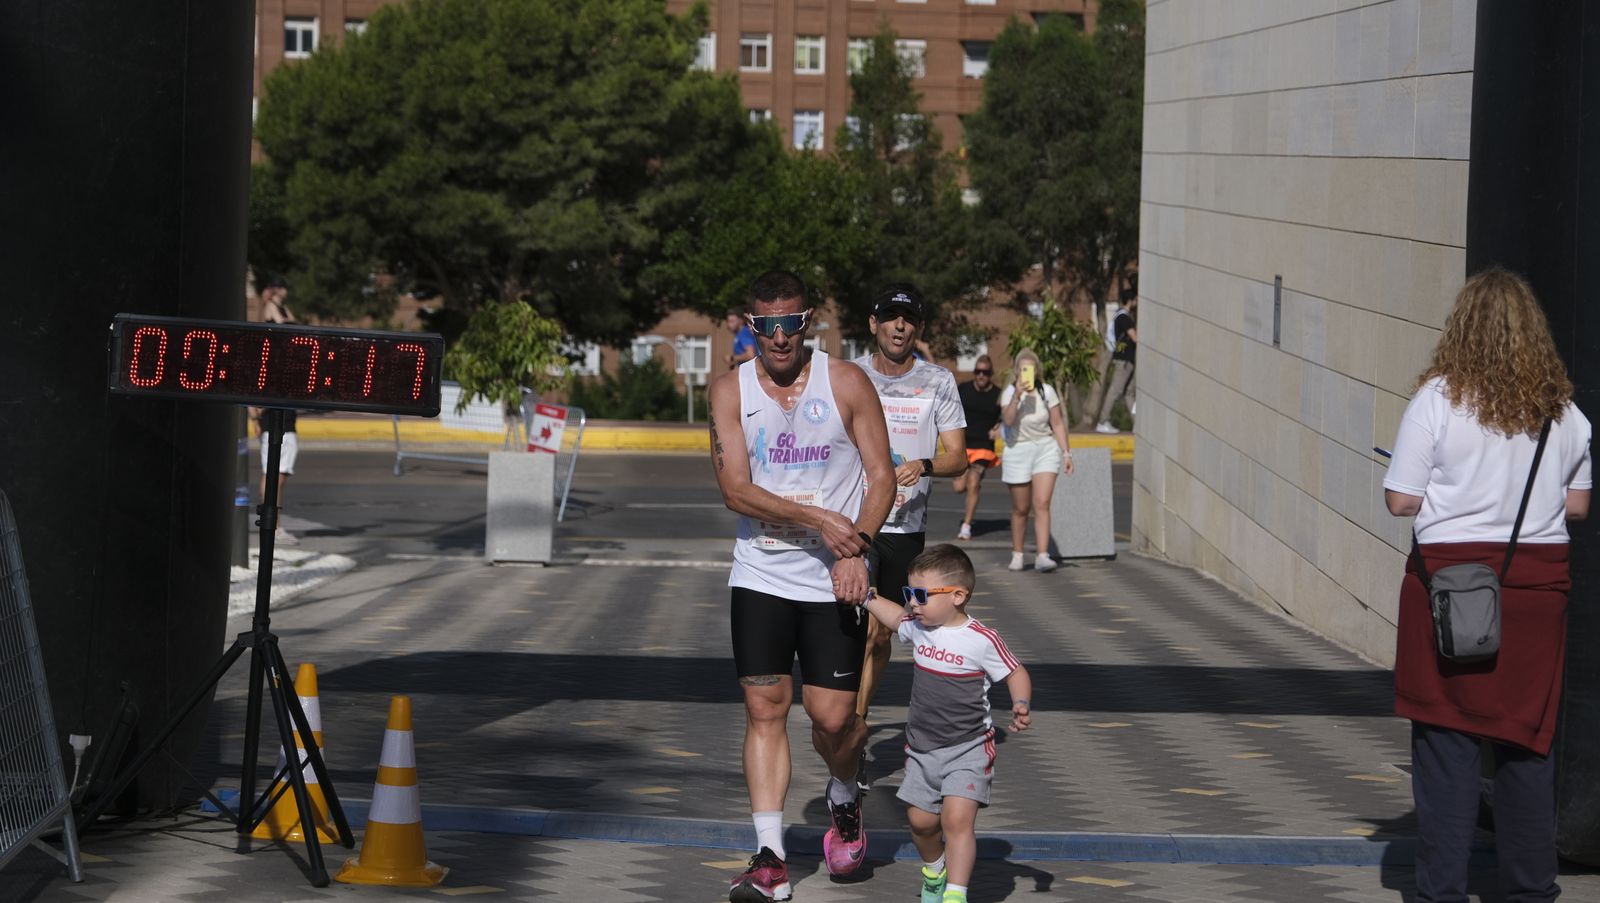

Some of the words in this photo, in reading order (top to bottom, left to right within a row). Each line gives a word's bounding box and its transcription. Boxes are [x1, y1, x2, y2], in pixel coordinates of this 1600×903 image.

[129, 327, 425, 400] 00:17:17
[768, 445, 831, 464] TRAINING
[917, 644, 964, 666] adidas
